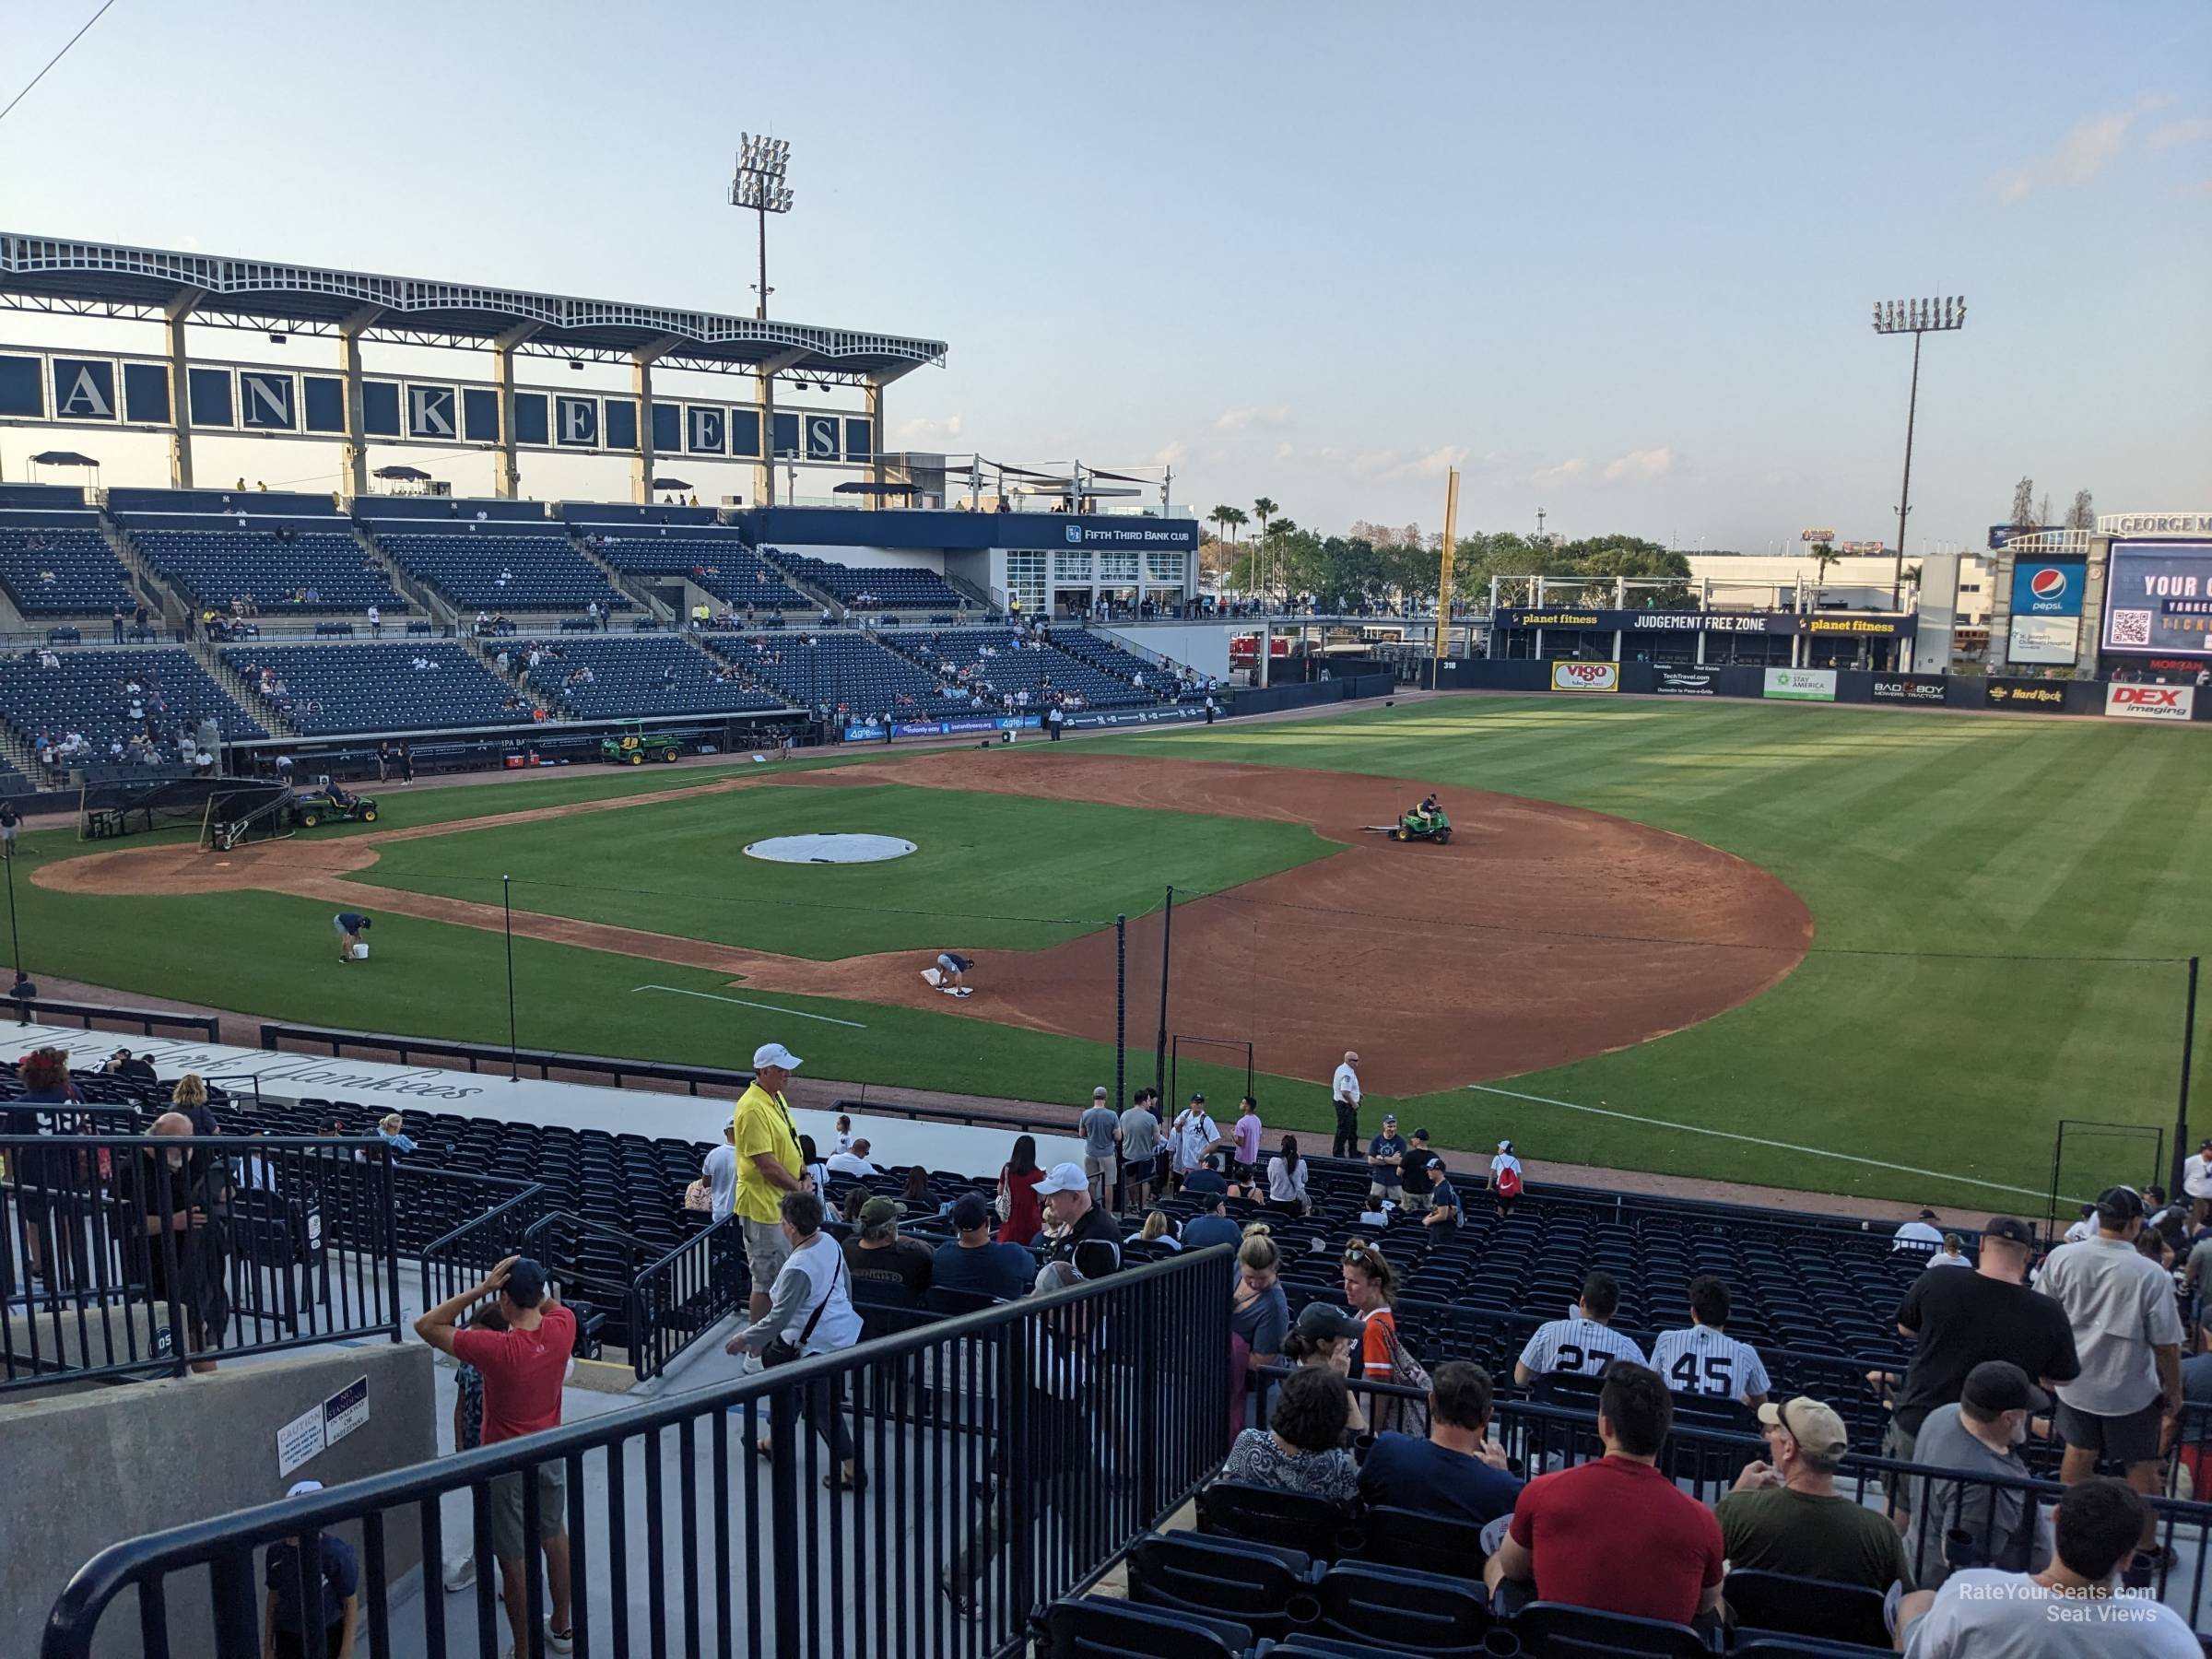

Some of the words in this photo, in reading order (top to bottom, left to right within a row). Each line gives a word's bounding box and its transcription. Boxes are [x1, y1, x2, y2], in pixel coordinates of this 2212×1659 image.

[2121, 517, 2193, 532] GEORGE
[1085, 530, 1112, 540] FIFTH
[1113, 530, 1142, 540] THIRD
[1145, 531, 1169, 541] BANK
[2145, 576, 2197, 596] YOUR
[2033, 602, 2063, 611] pepsi
[1523, 614, 1558, 625] planet
[1560, 614, 1598, 624] fitness
[1635, 616, 1702, 629] JUDGEMENT
[1705, 617, 1732, 629] FREE
[1735, 618, 1767, 631] ZONE
[1811, 620, 1850, 632] planet
[1853, 620, 1895, 632] fitness
[1875, 683, 1901, 692] BAD
[2012, 688, 2038, 699] Hard
[2038, 689, 2062, 702] Rock
[2112, 687, 2182, 706] DEX
[2127, 705, 2187, 716] imaging
[221, 1053, 484, 1099] Yankees
[159, 1334, 171, 1350] 05
[1557, 1344, 1614, 1376] 27
[1671, 1353, 1731, 1397] 45
[280, 1409, 320, 1444] CAUTION
